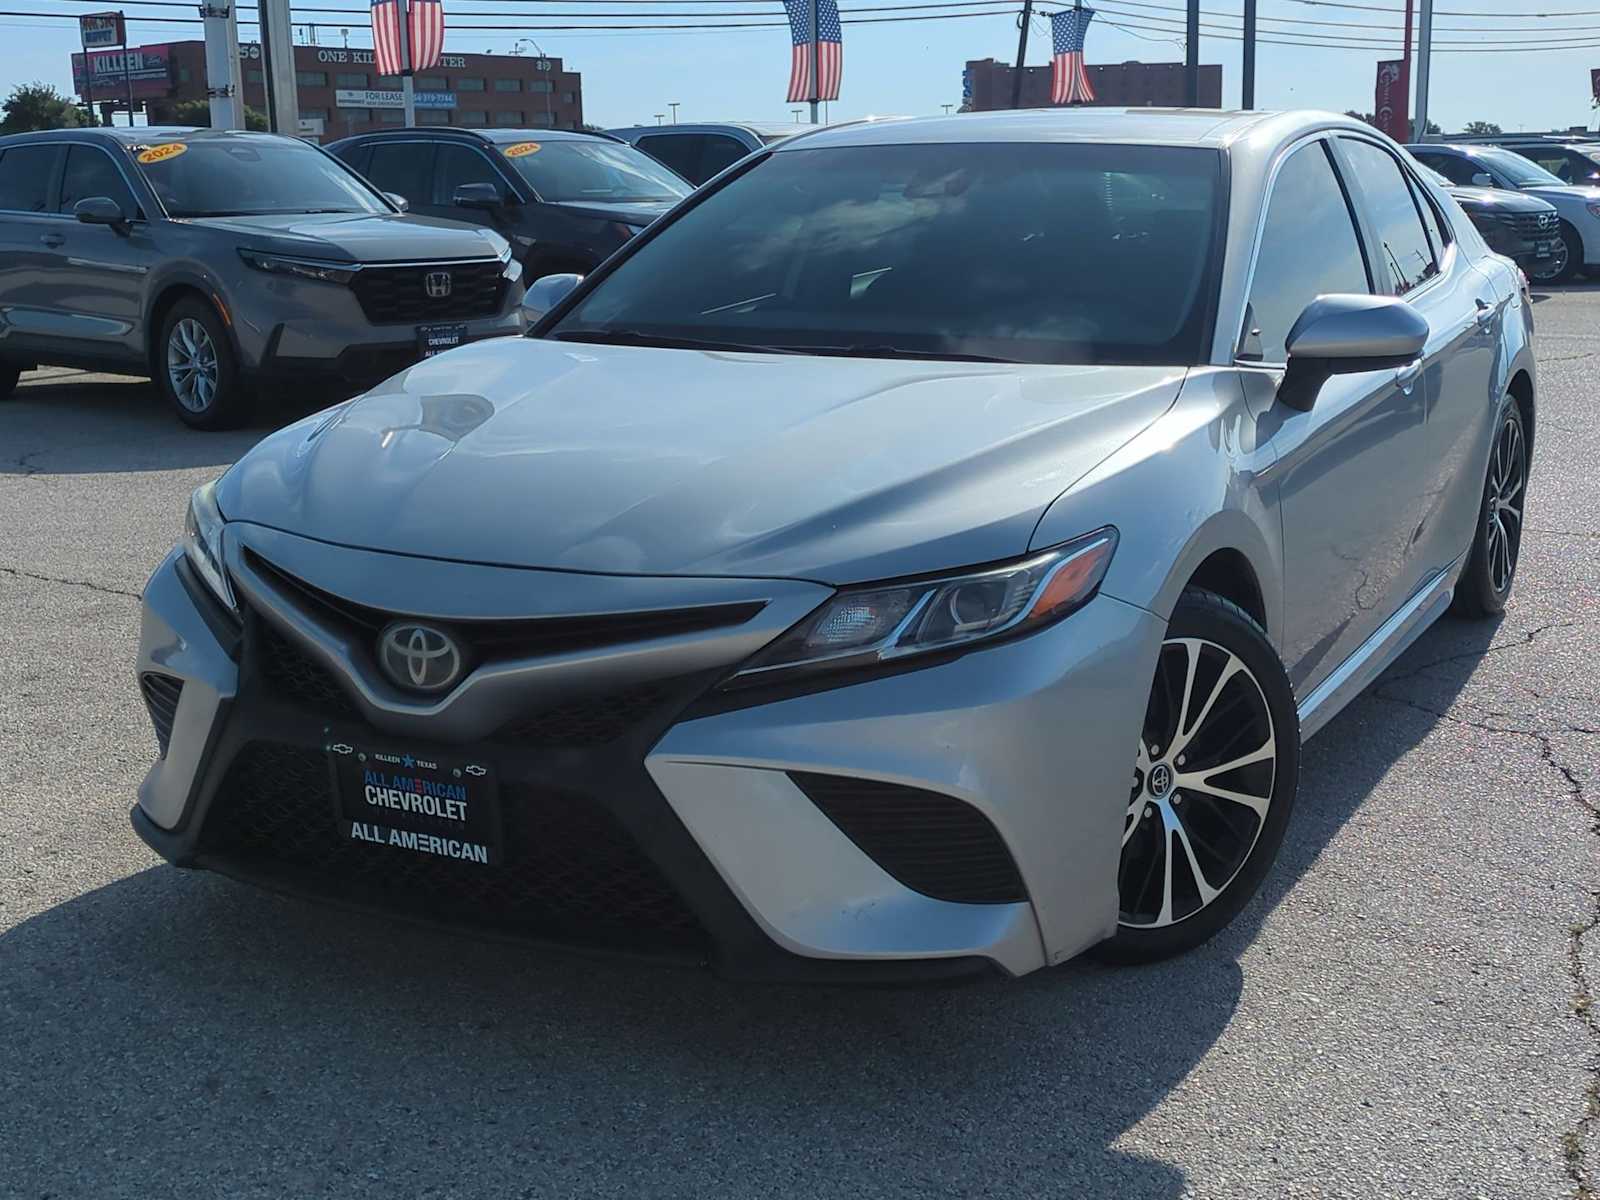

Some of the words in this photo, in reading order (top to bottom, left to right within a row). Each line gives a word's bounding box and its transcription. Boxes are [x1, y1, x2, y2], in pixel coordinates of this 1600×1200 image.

[317, 50, 348, 63] ONE
[365, 91, 381, 101] FOR
[141, 145, 183, 161] 2024
[507, 143, 538, 156] 2024
[375, 753, 401, 764] KILLEEN
[416, 759, 438, 770] TEXAS
[363, 768, 390, 787] ALL
[393, 775, 468, 800] AMERICAN
[364, 784, 468, 822] CHEVROLET
[351, 821, 385, 844] ALL
[389, 829, 489, 864] AMERICAN
